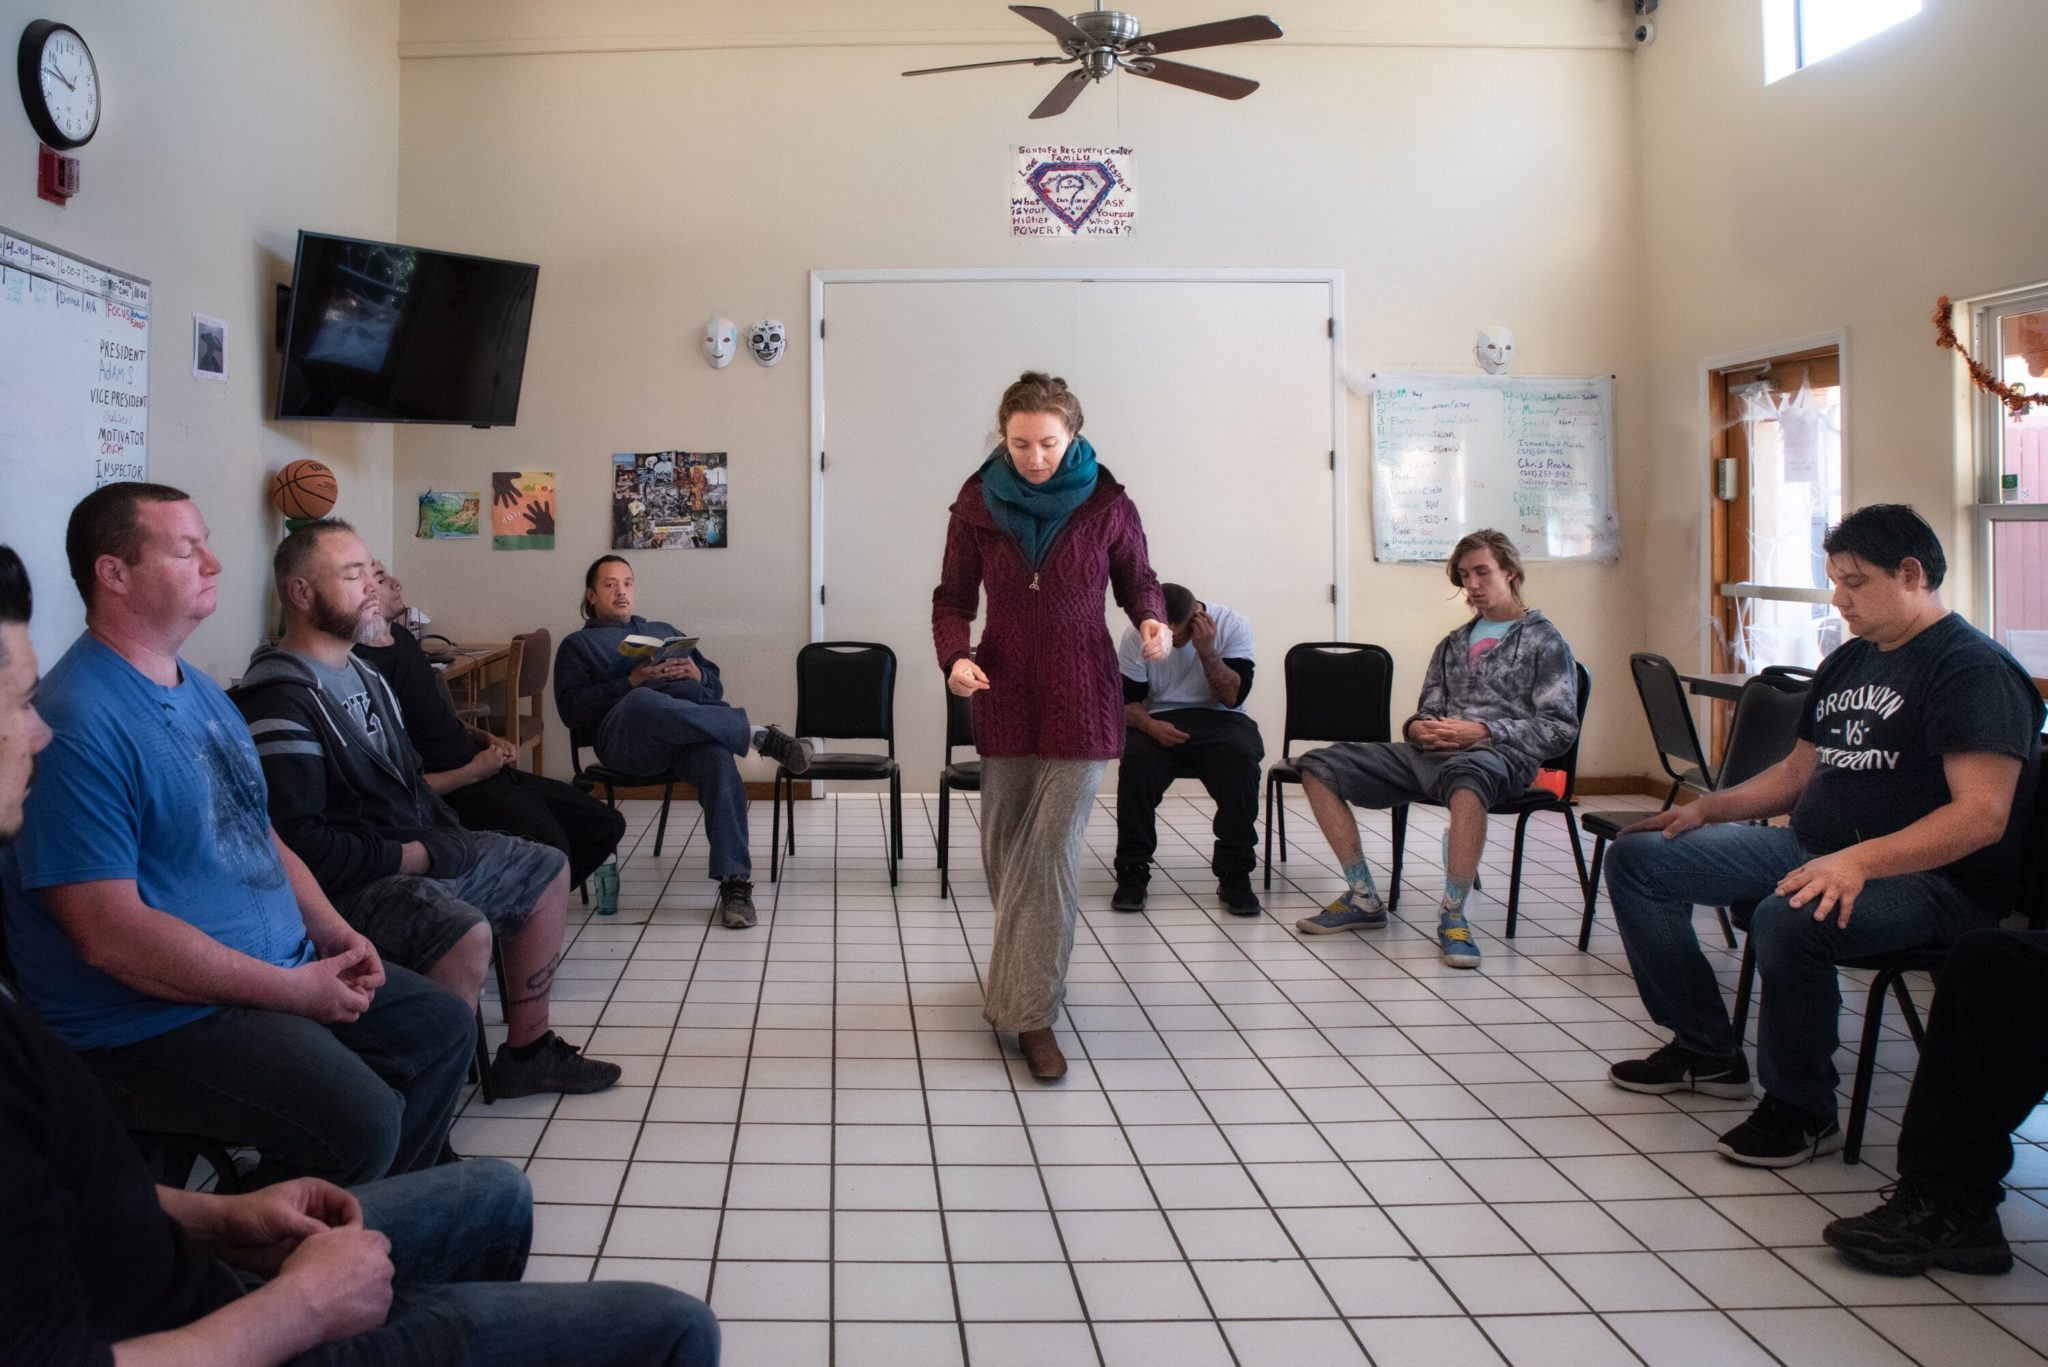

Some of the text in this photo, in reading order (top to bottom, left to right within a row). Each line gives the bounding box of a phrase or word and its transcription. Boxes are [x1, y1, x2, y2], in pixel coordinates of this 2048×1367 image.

[66, 40, 75, 56] 12
[1060, 146, 1103, 156] Recovery
[1103, 146, 1134, 155] Center
[1011, 197, 1041, 206] What
[108, 302, 131, 321] FOCUS
[99, 338, 146, 362] PRESIDENT
[90, 388, 148, 408] VICE PRESIDENT
[97, 427, 145, 446] MOTIVATOR
[95, 459, 144, 481] INSPECTOR
[1517, 457, 1544, 470] Chris
